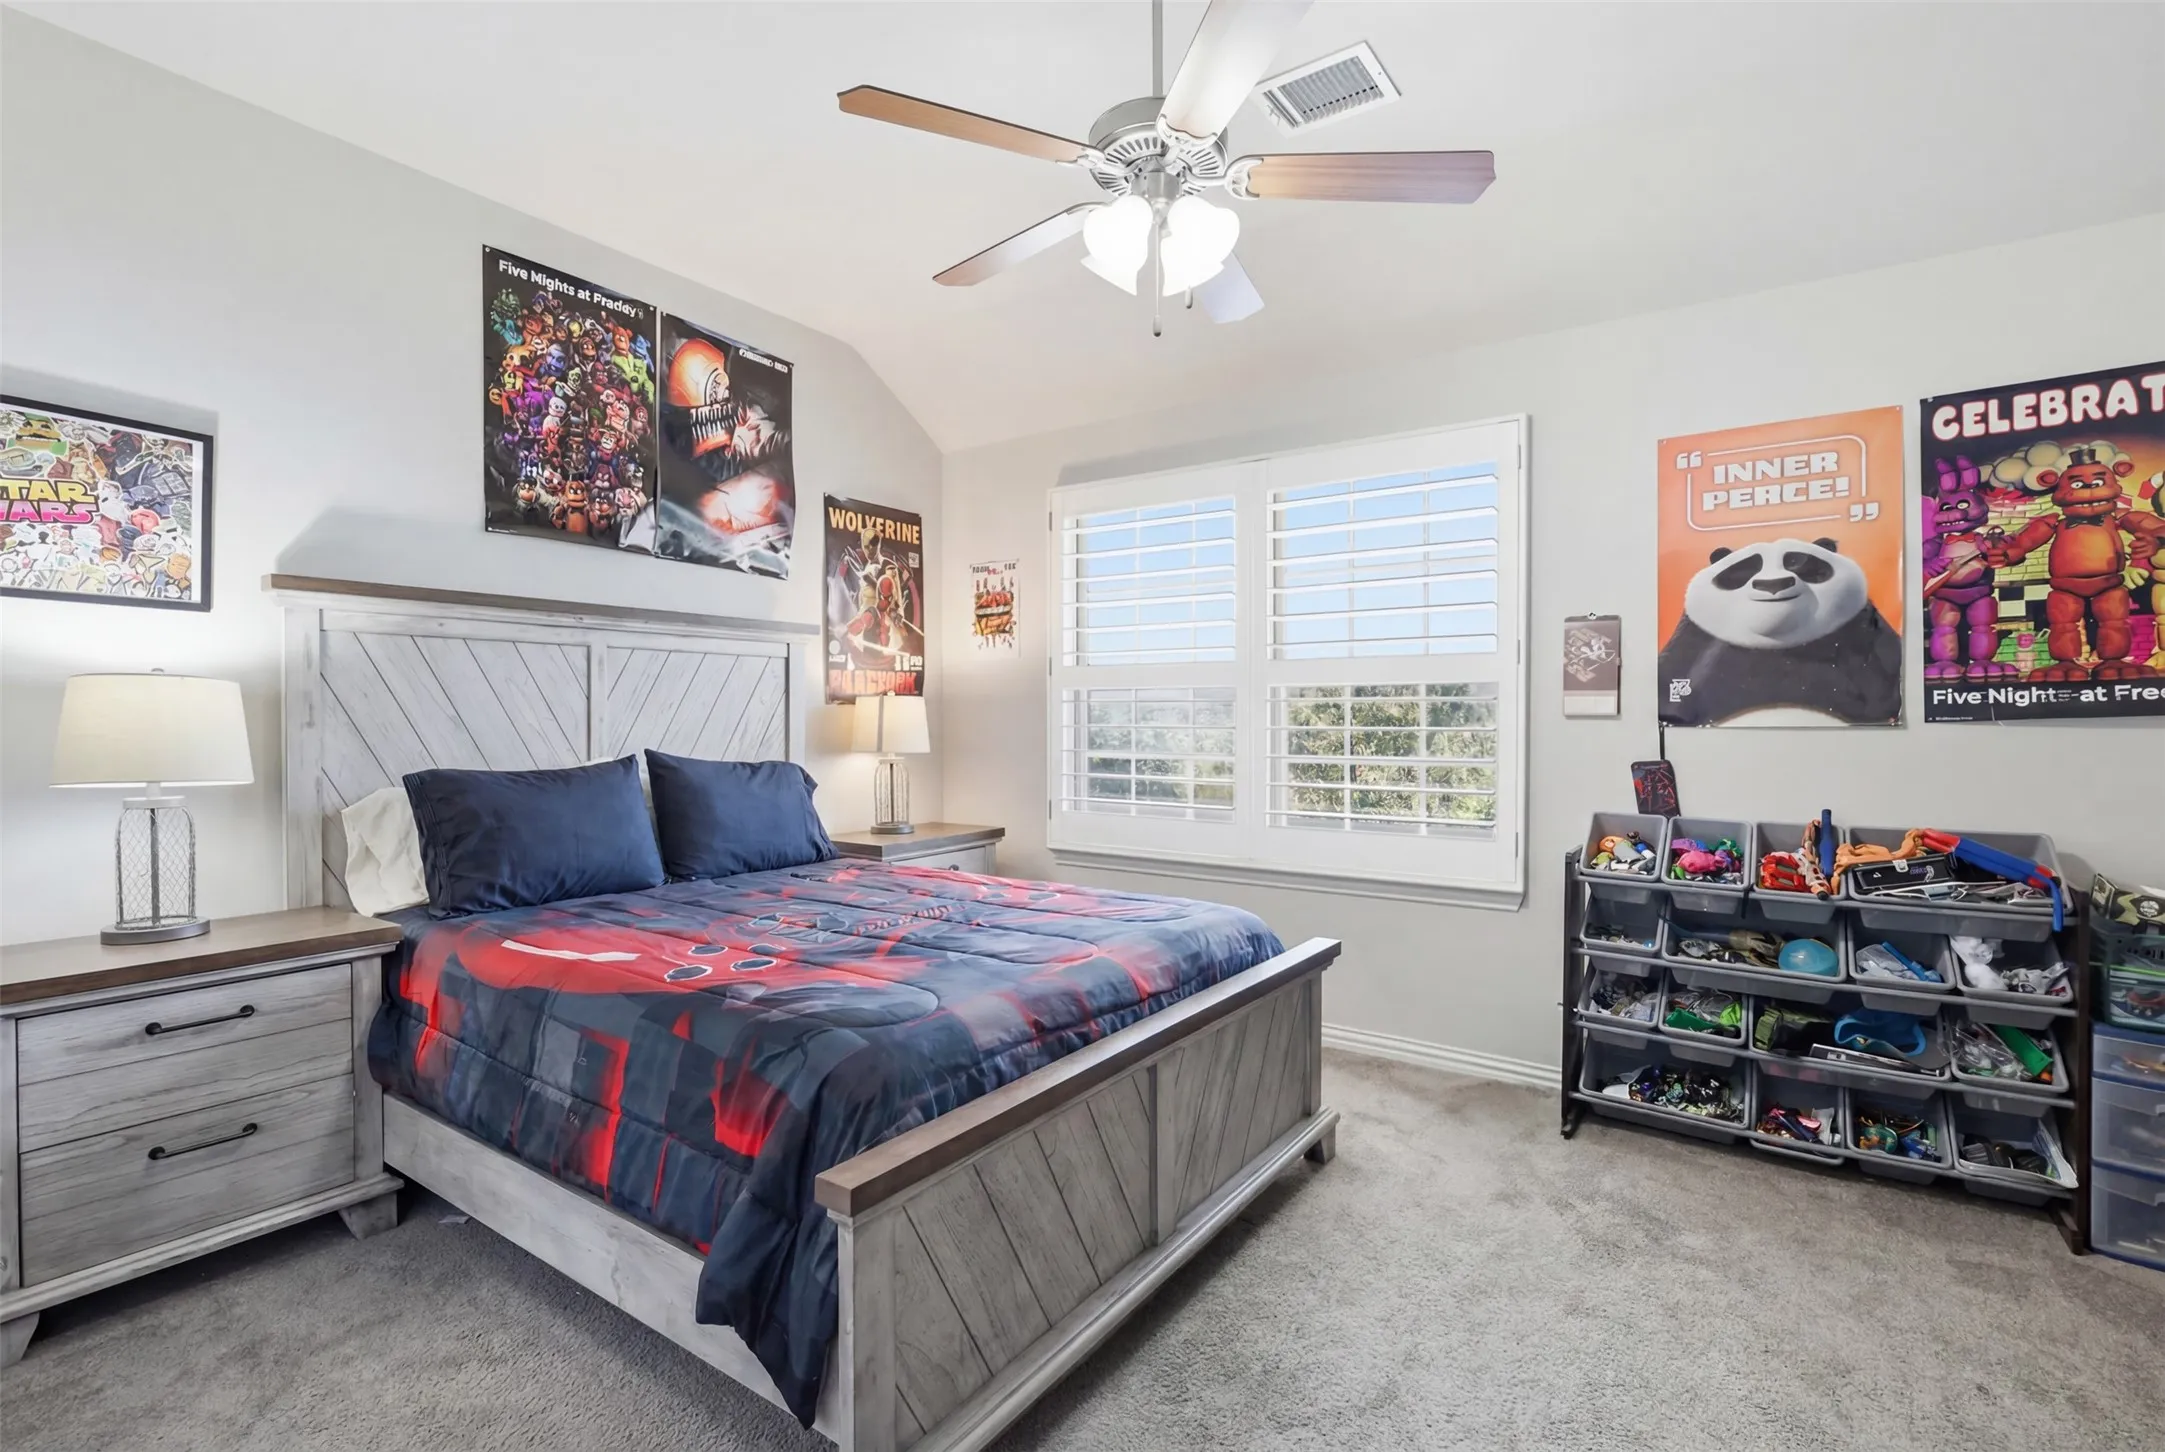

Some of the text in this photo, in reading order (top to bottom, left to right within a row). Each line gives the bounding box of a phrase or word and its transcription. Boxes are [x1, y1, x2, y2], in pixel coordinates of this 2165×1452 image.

[498, 259, 528, 280] Five
[577, 289, 592, 302] at
[1713, 452, 1838, 485] INNER
[0, 478, 96, 503] TAR
[828, 506, 920, 545] WOLVERINE
[1932, 689, 1982, 705] Five
[2079, 686, 2108, 702] at
[2114, 684, 2165, 701] Fre
